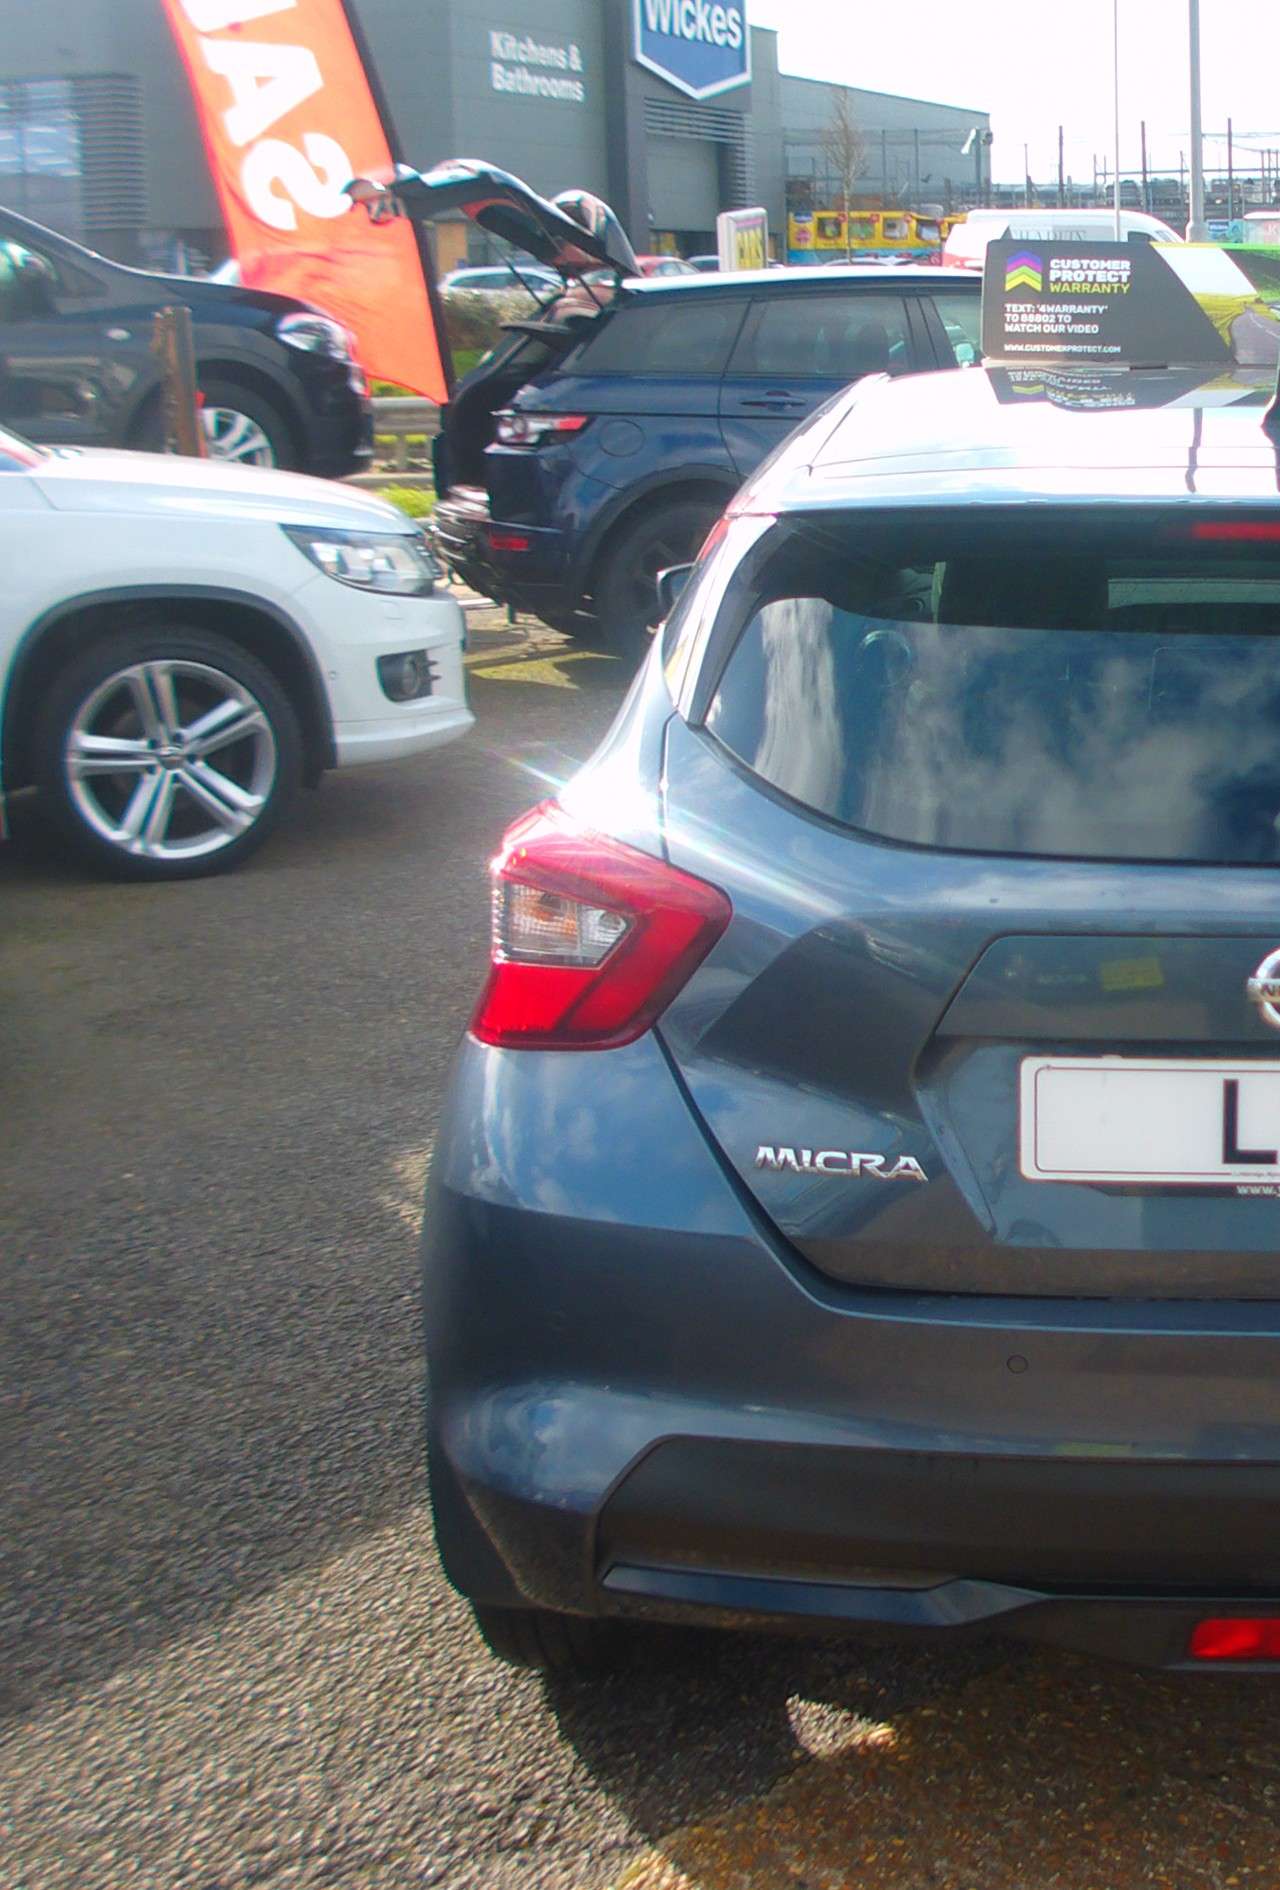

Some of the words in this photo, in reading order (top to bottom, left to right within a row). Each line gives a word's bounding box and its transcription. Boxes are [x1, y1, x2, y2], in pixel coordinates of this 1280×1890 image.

[644, 0, 742, 48] Wickes
[490, 30, 567, 68] Kitchens
[569, 45, 582, 71] &
[491, 62, 585, 101] Bathrooms
[1050, 259, 1131, 271] CUSTOMER
[1050, 270, 1131, 283] PROTECT
[1050, 282, 1131, 294] WARRANTY
[1004, 304, 1035, 313] TEXT:
[1004, 313, 1019, 323] TO
[1057, 314, 1072, 324] TO
[1004, 323, 1041, 333] WATCH
[1042, 324, 1066, 333] OUR
[1067, 324, 1099, 334] VIDEO
[755, 1145, 929, 1182] MICRA
